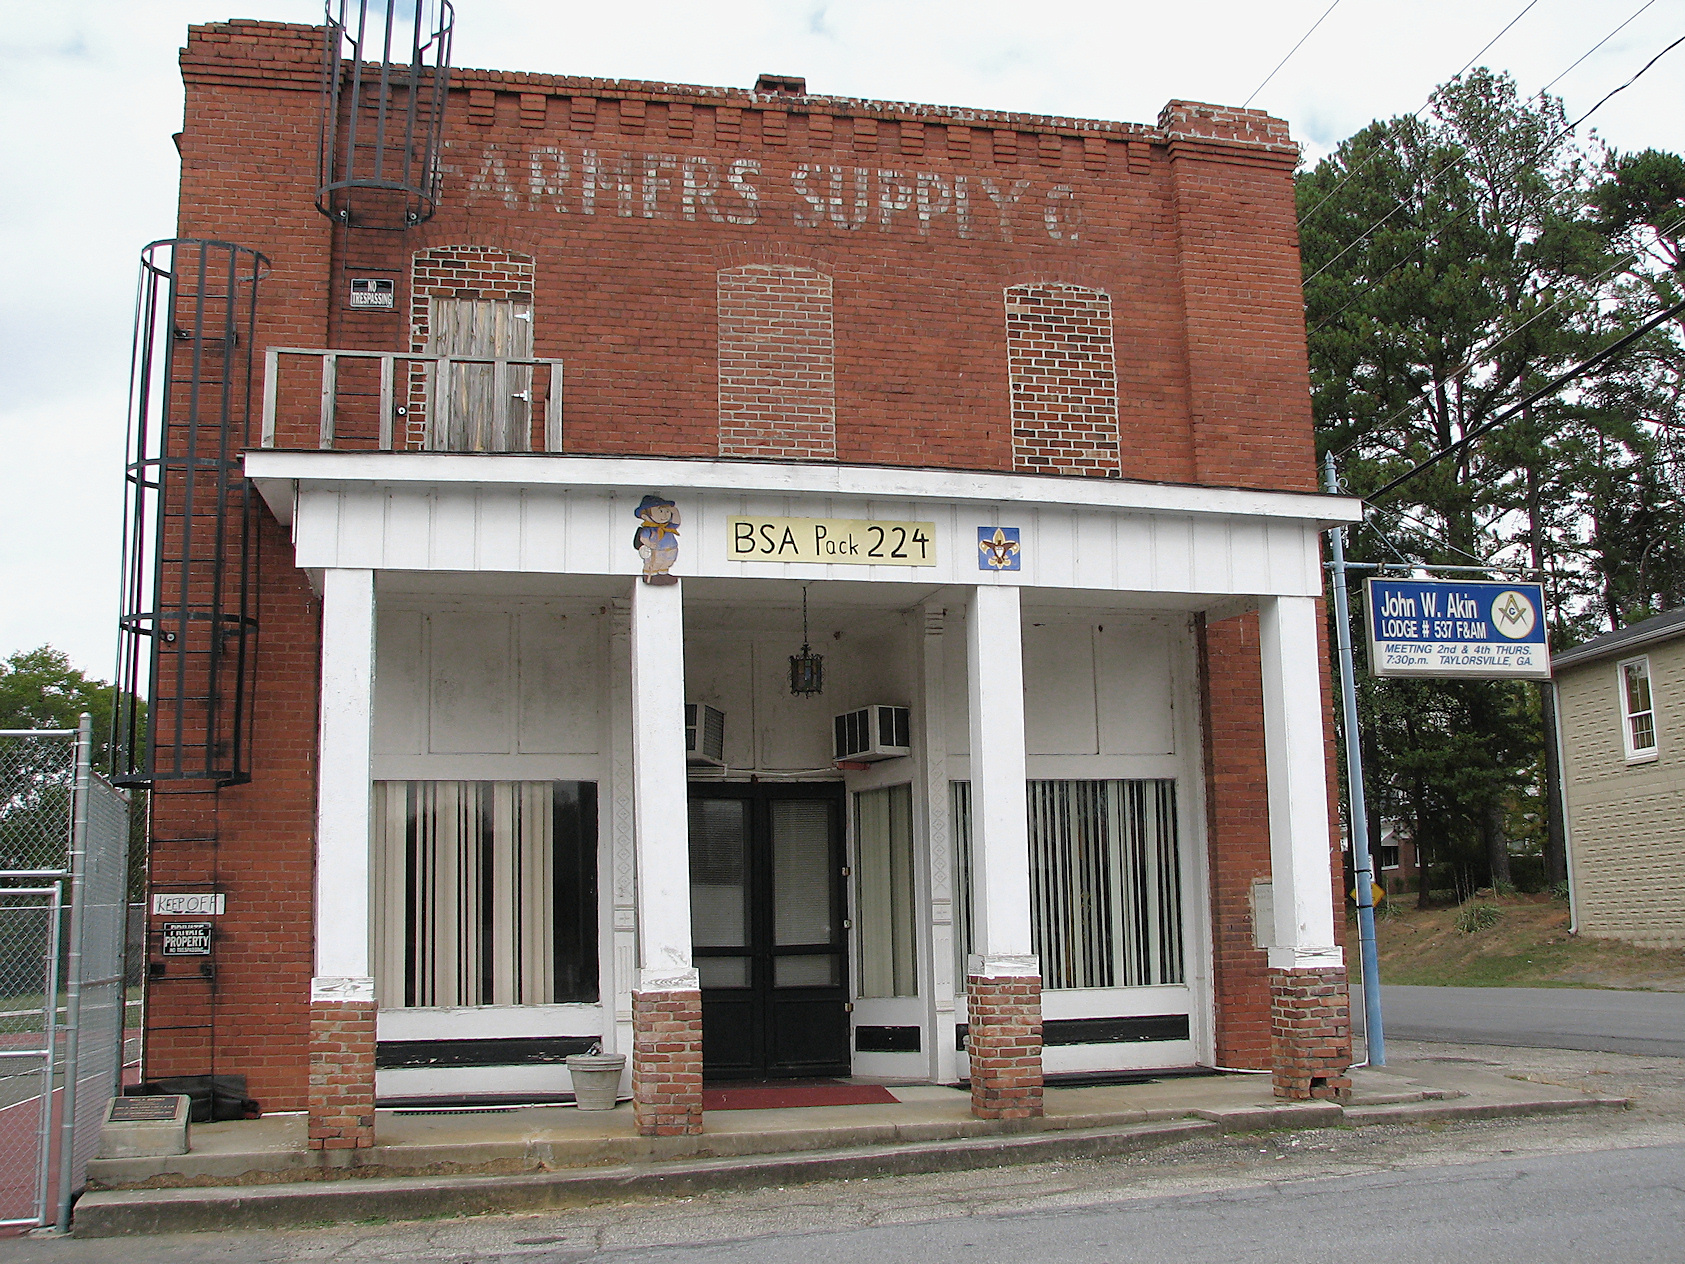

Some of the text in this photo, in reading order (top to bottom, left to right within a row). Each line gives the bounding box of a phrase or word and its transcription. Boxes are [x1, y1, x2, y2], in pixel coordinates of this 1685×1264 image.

[367, 280, 377, 293] NO
[352, 292, 392, 304] TRESPASSING
[735, 522, 930, 559] BSA Pack 224
[1380, 590, 1478, 619] John W. Akin
[1381, 619, 1487, 639] LODGE # 537 F&AM
[1384, 644, 1532, 655] MEETING 2nd & 4th THURS.
[1386, 655, 1534, 667] 7:30p.m. TAYLORSVILLE, GA.
[157, 895, 219, 912] KEEP OFF
[170, 925, 204, 936] PRIVATE
[165, 936, 209, 947] PROPERTY
